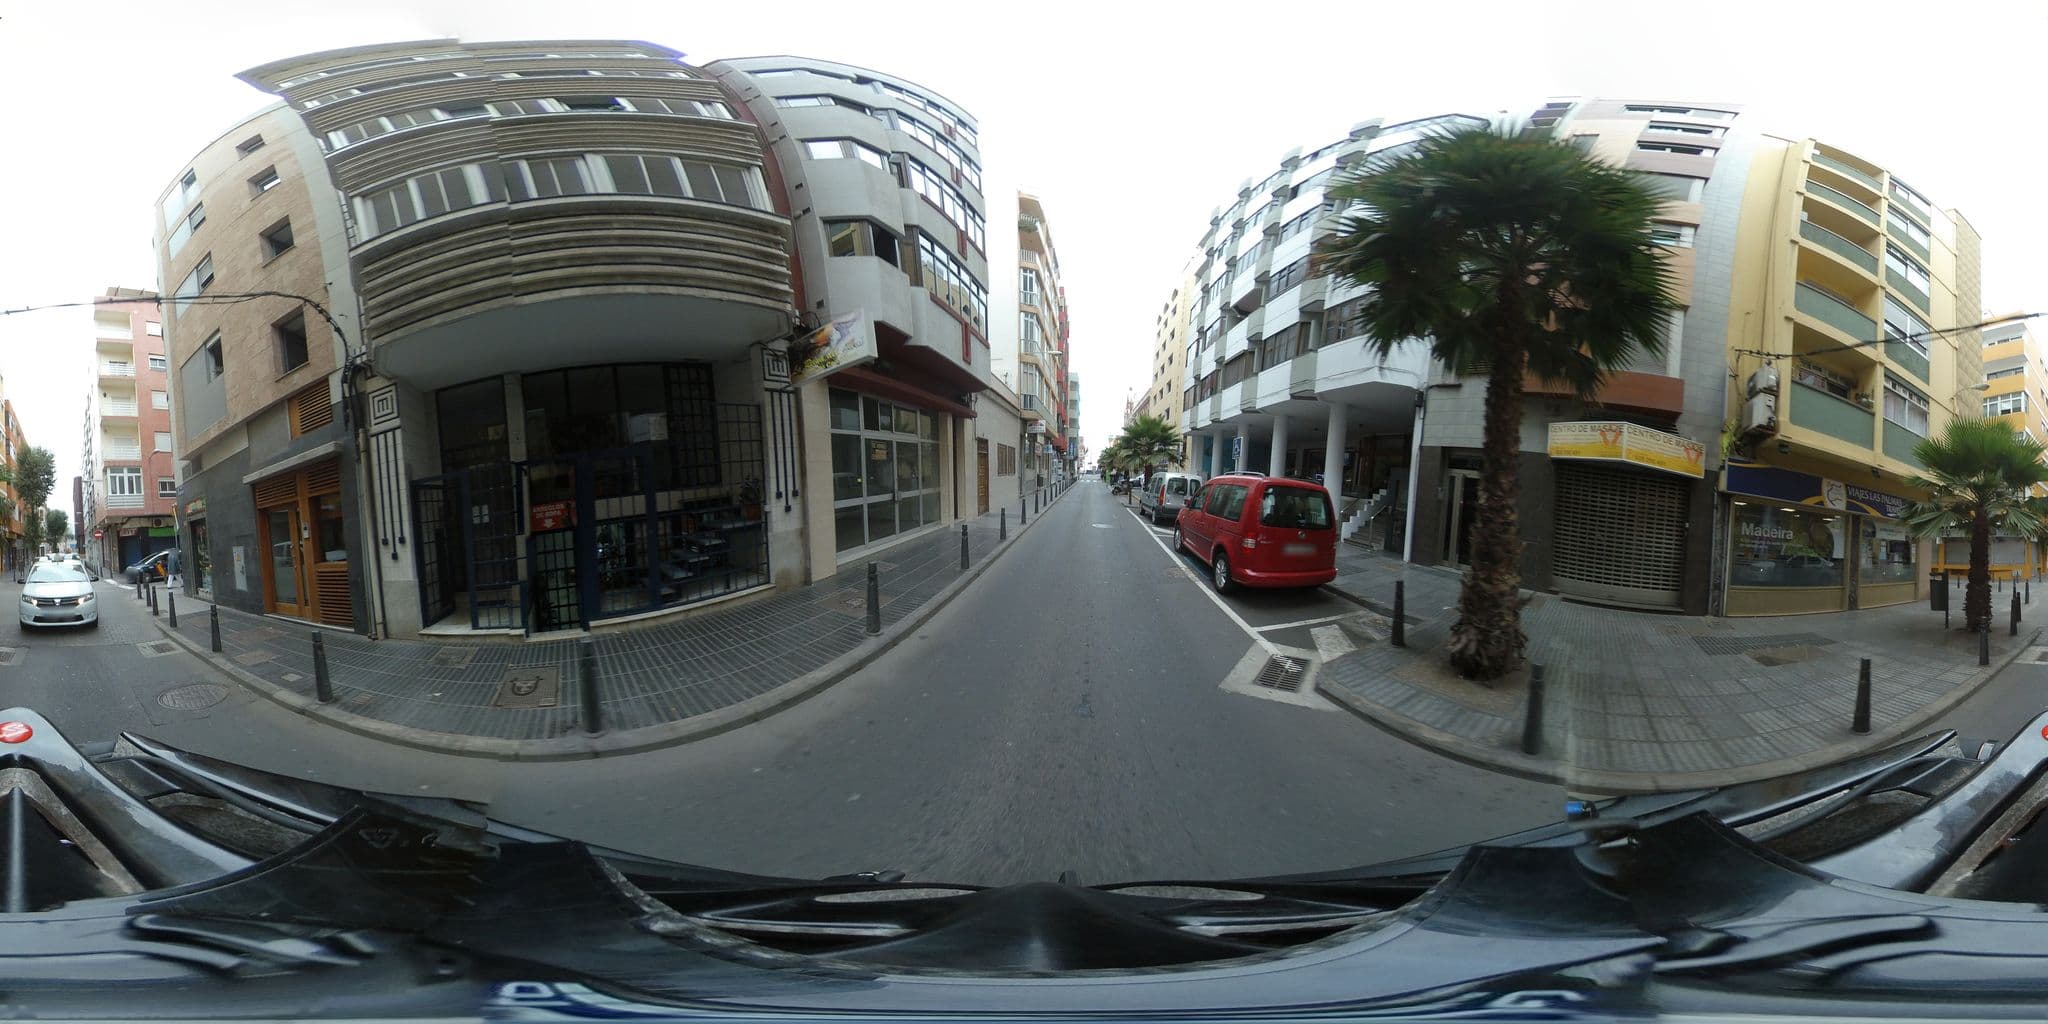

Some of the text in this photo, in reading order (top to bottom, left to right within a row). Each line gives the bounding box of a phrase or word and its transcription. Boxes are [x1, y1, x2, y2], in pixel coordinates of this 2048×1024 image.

[1578, 424, 1588, 432] DE
[1626, 425, 1661, 442] CENTRO
[1663, 435, 1673, 446] DE
[1847, 485, 1869, 500] VIAJES
[1869, 490, 1881, 502] LAS
[1741, 521, 1793, 540] Madeira
